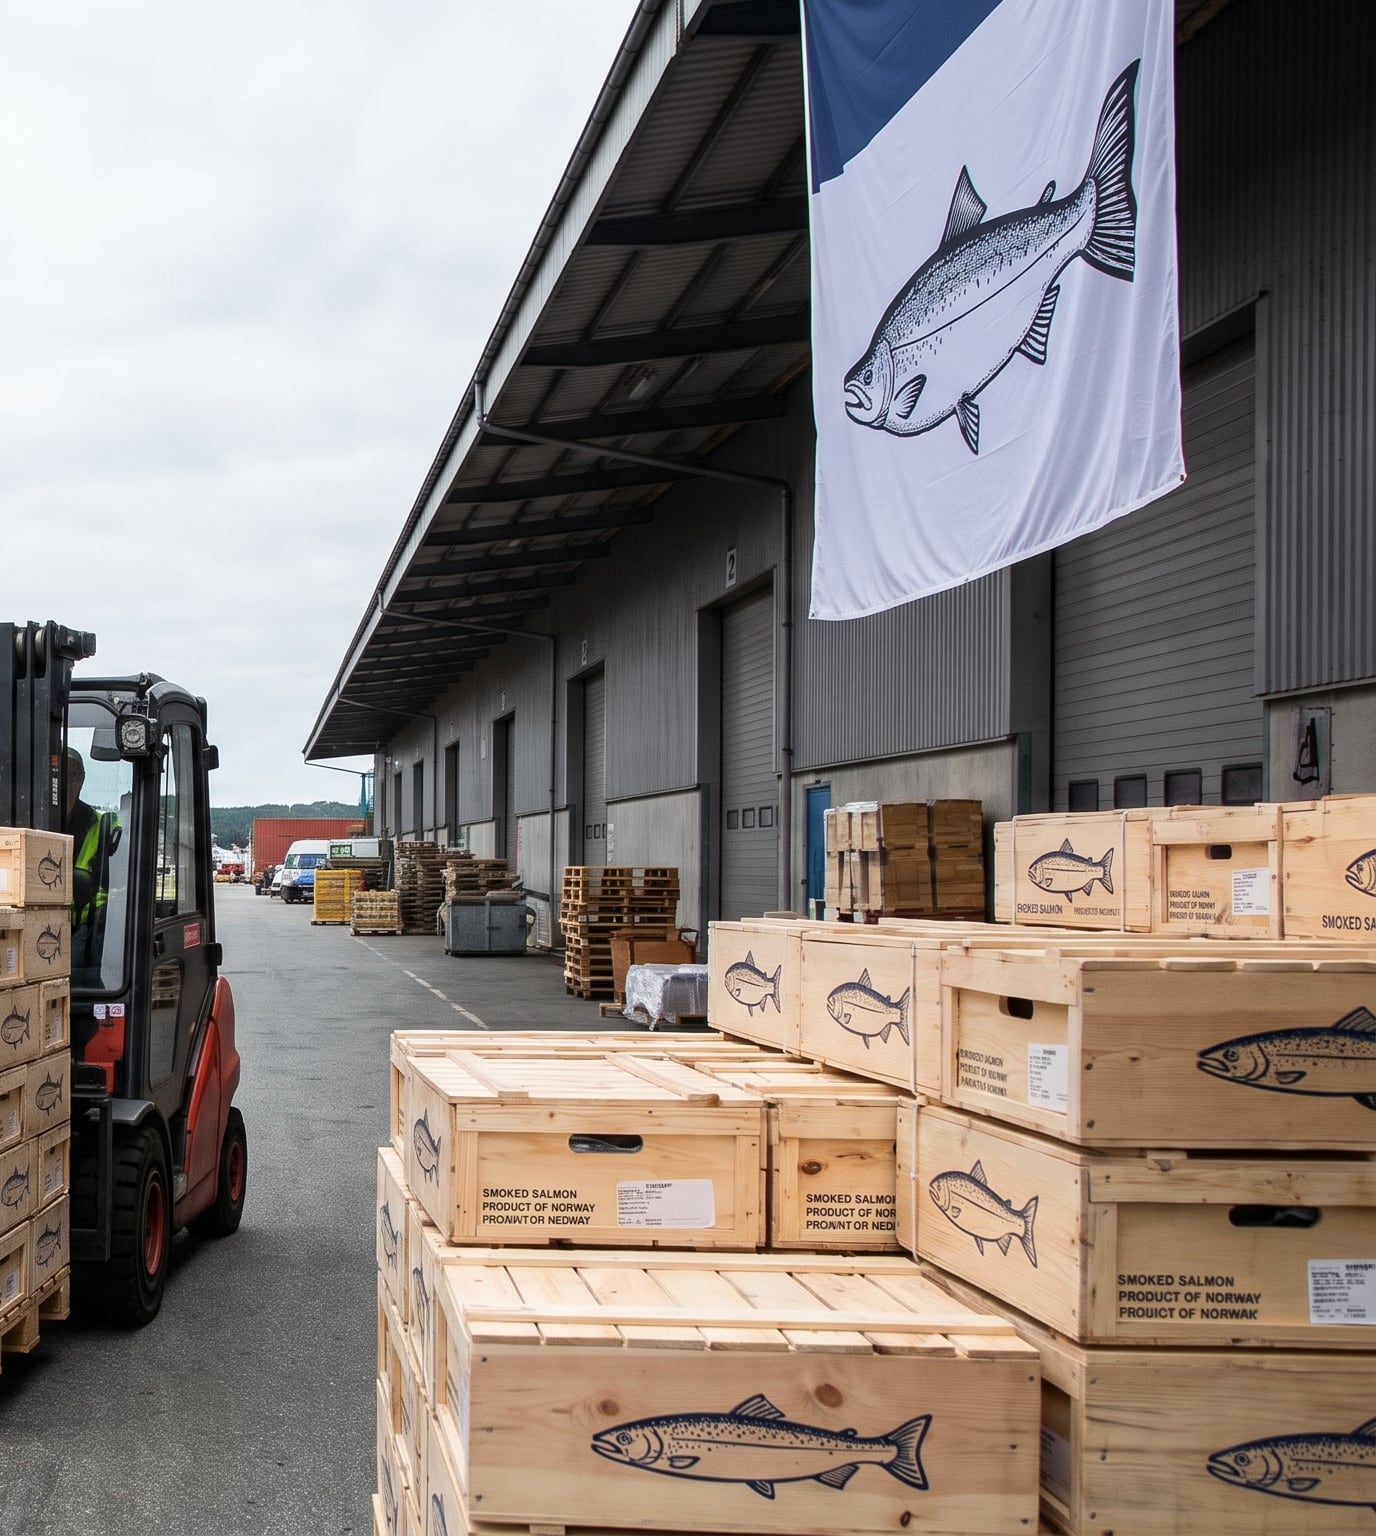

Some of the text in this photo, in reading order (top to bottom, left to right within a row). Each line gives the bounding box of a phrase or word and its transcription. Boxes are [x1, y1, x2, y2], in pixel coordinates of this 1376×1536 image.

[1322, 914, 1362, 930] SMOKED
[482, 1188, 577, 1199] SMOKED SALMON
[806, 1193, 852, 1204] SMOKED
[482, 1202, 596, 1213] PRODUCT OF NORWAY
[806, 1207, 855, 1218] PRODUCT
[875, 1208, 896, 1218] NOR
[548, 1215, 591, 1225] NEDWAY
[1118, 1274, 1235, 1287] SMOKED SALMON
[1119, 1291, 1262, 1304] PRODUCT OF NORWAY
[1178, 1308, 1196, 1319] OF
[1200, 1308, 1258, 1320] NORWAK
